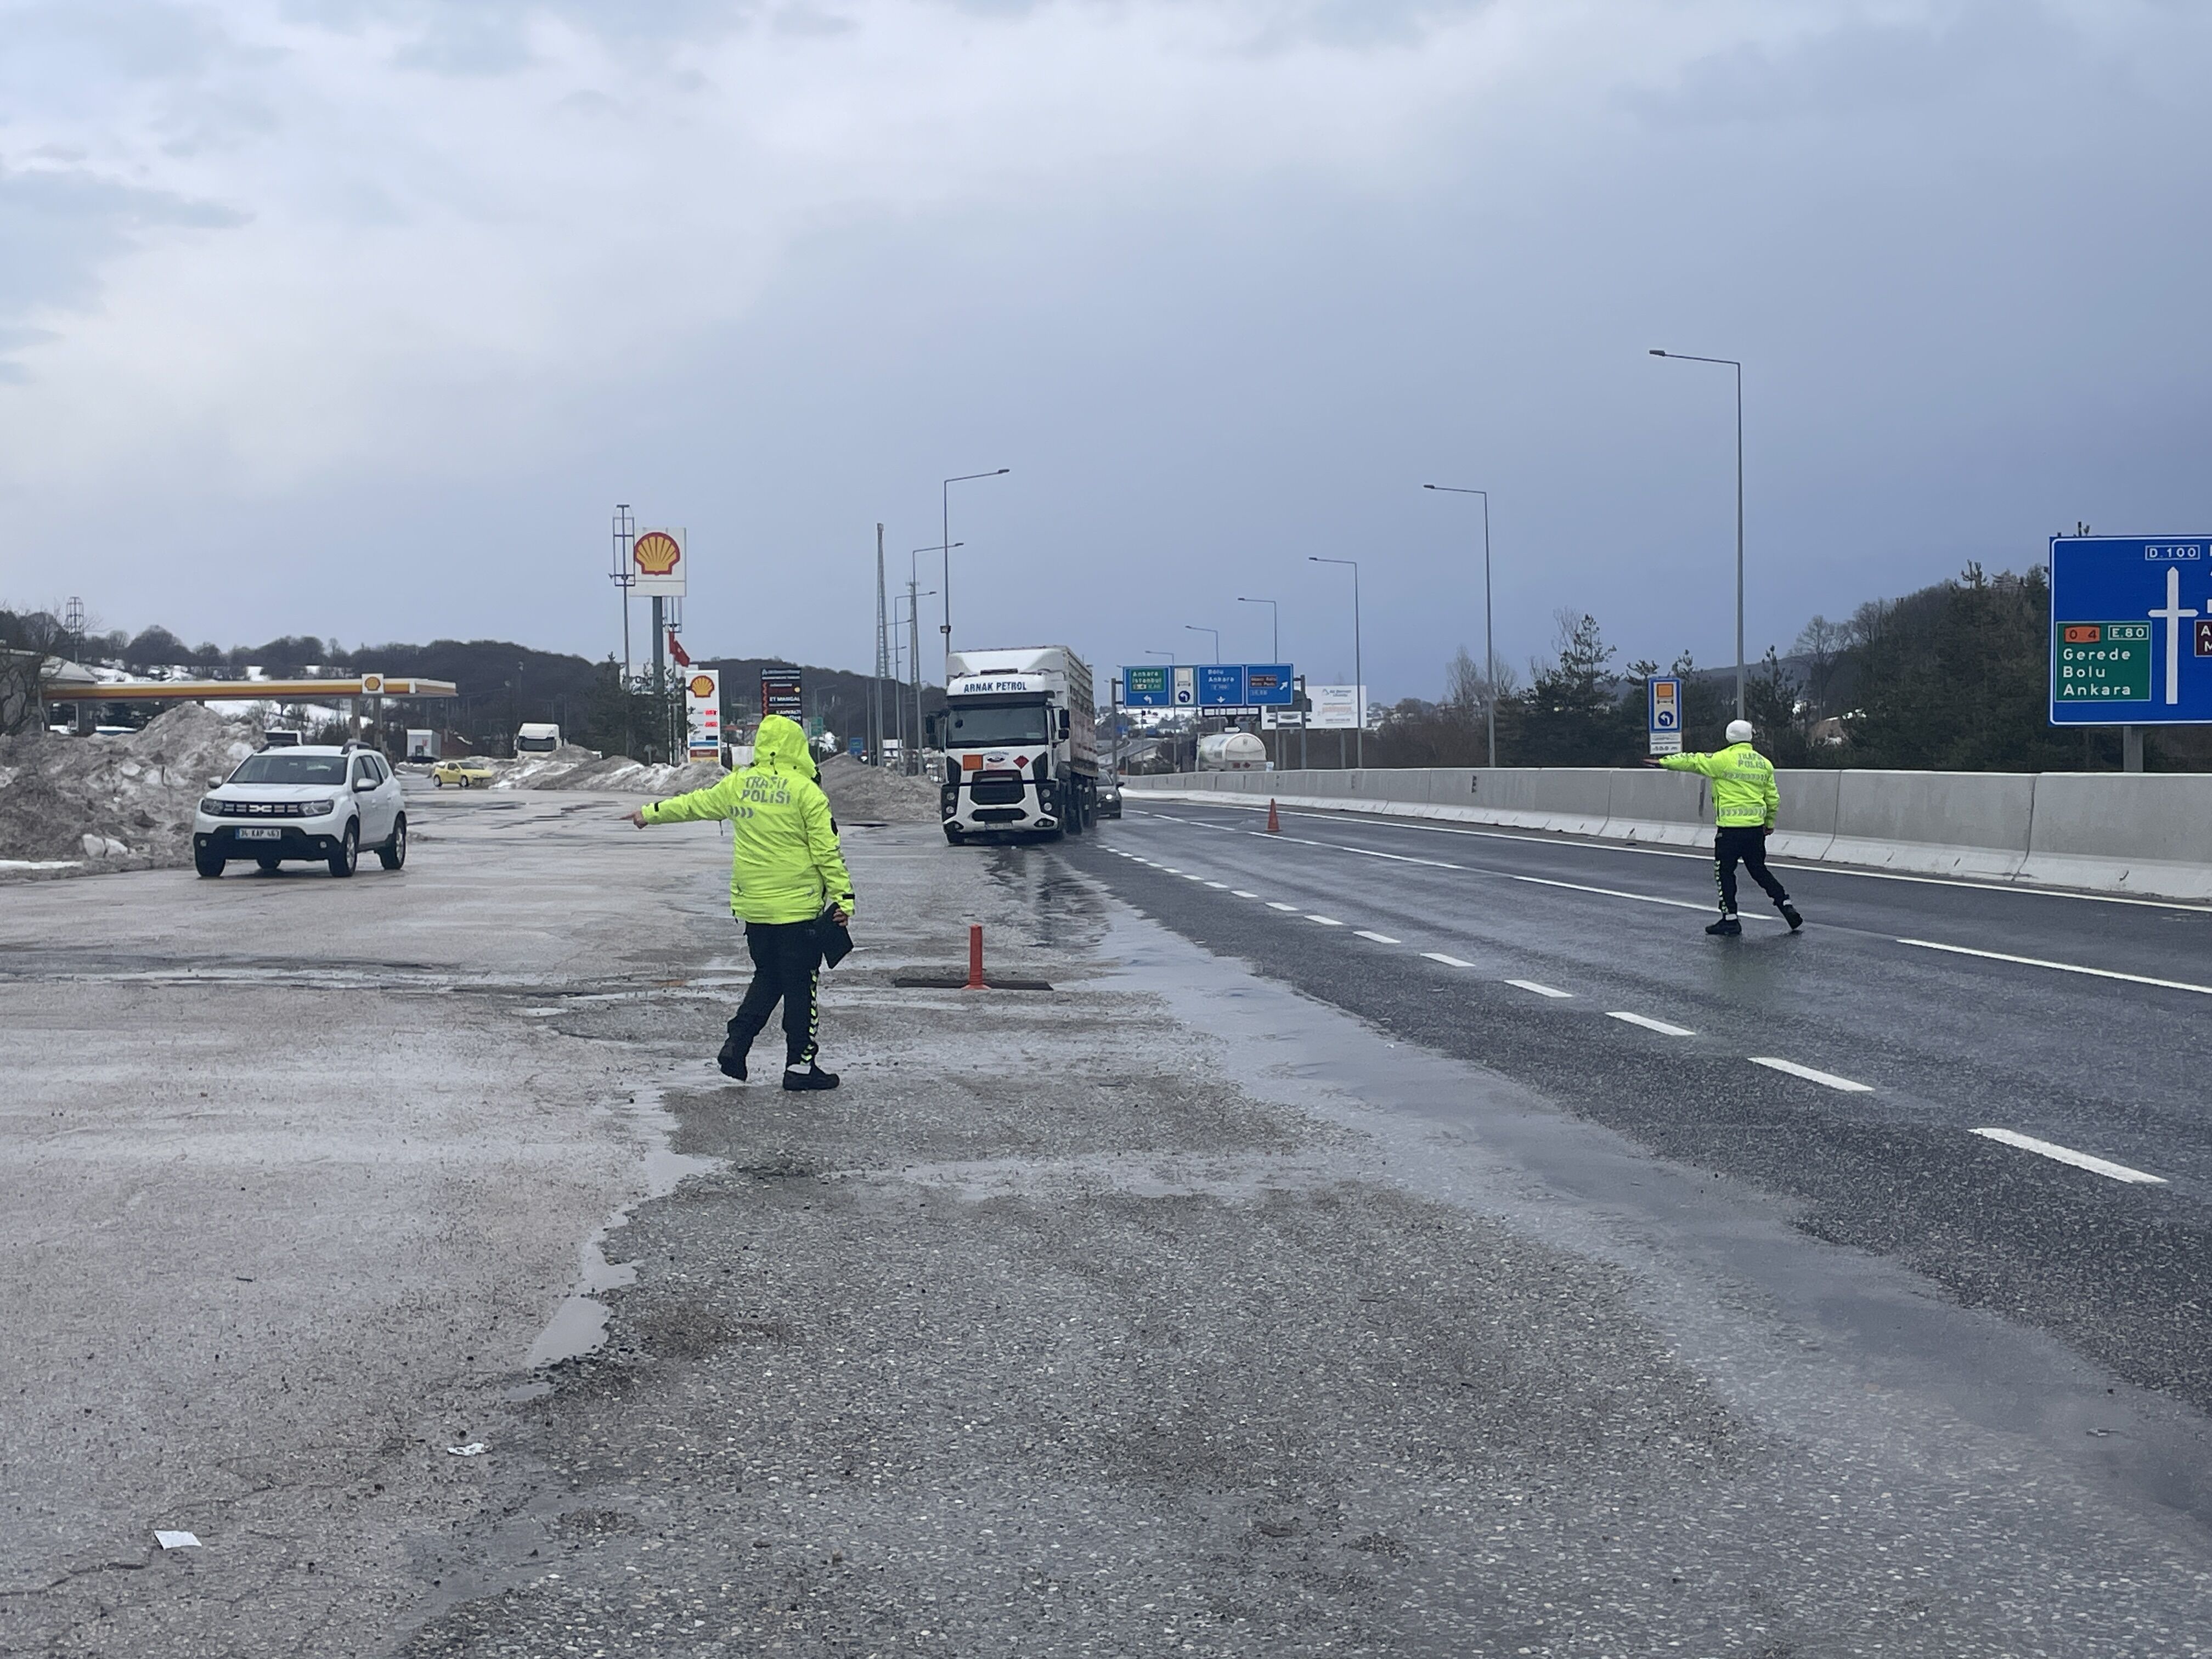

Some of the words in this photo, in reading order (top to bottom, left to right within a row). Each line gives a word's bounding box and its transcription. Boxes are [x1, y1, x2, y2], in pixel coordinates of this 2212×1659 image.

[2149, 548, 2196, 558] D.100
[2112, 628, 2145, 637] E.80
[2063, 647, 2131, 661] Gerede
[2063, 665, 2106, 678] Bolu
[996, 681, 1027, 691] PETROL
[2063, 683, 2131, 696] Ankara
